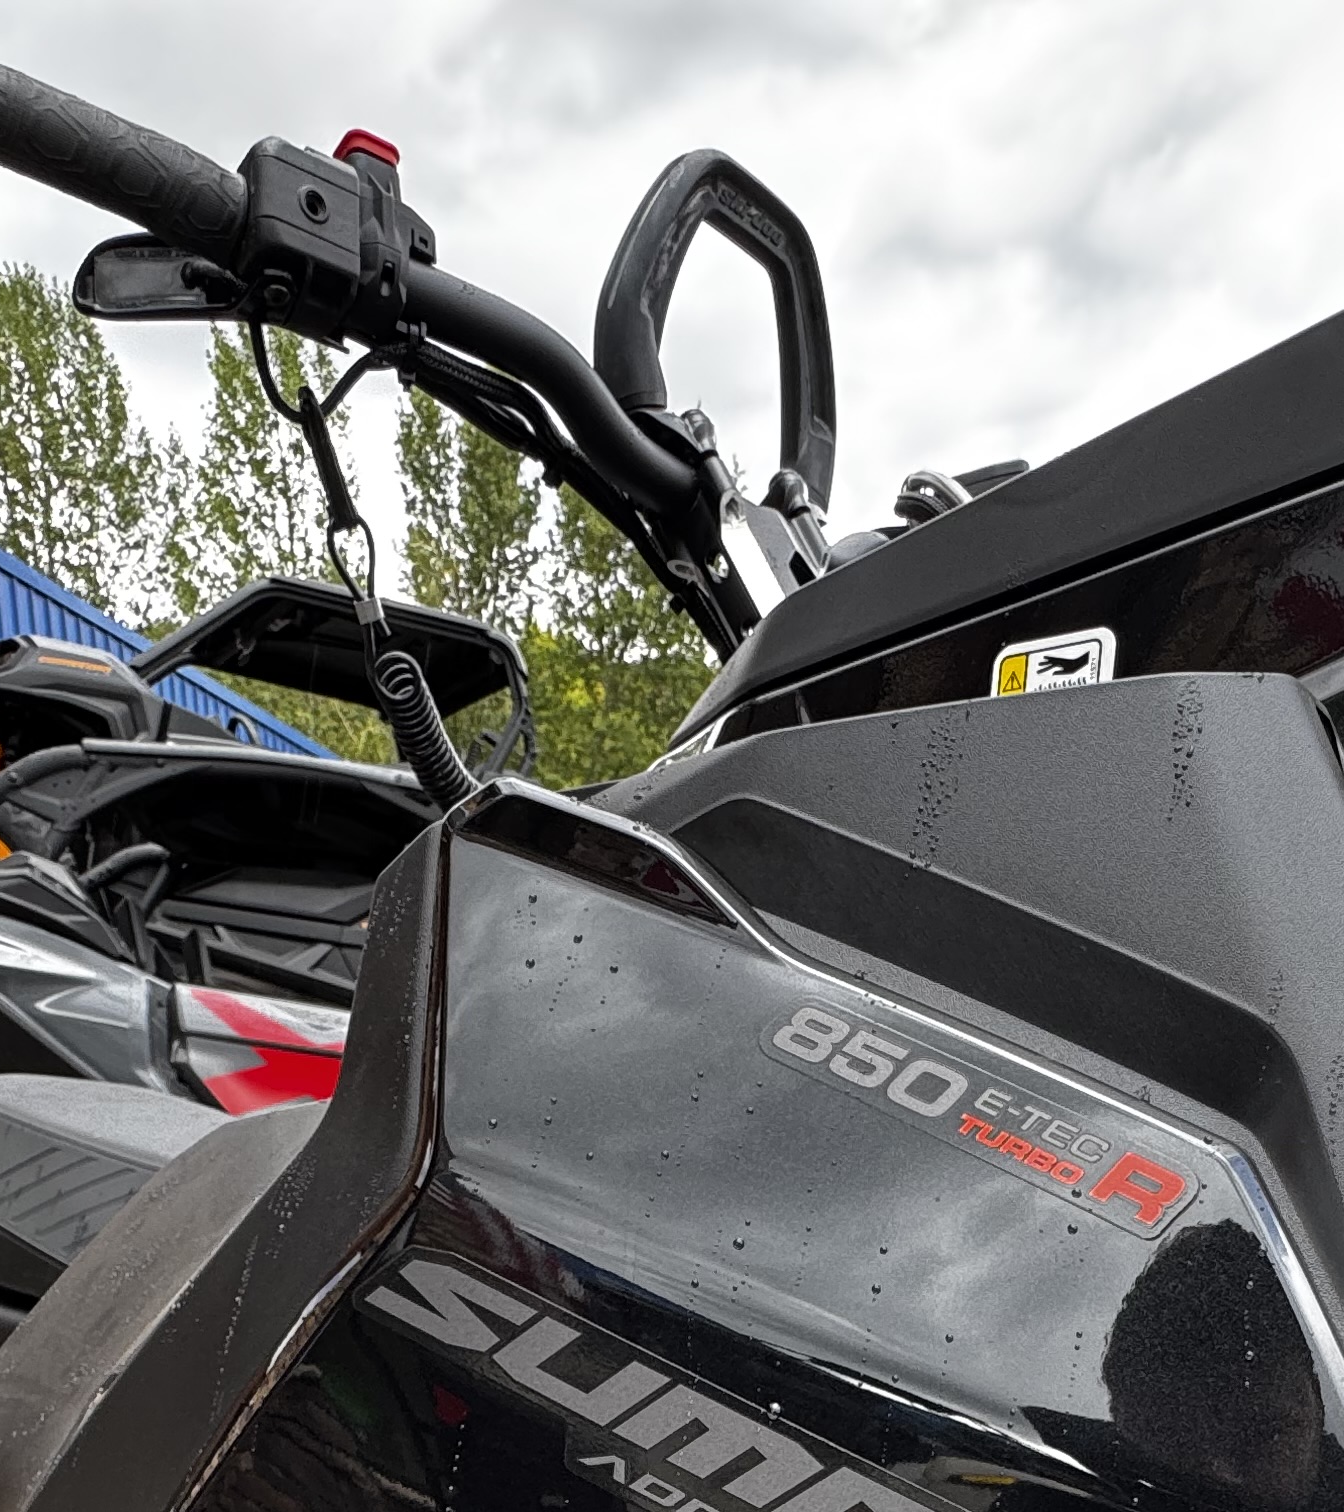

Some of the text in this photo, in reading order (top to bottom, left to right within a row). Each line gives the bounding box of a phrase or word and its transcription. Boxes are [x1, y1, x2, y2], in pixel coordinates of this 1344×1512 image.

[772, 1007, 1112, 1164] 850 E-TEC
[957, 1113, 1187, 1227] TURBO R
